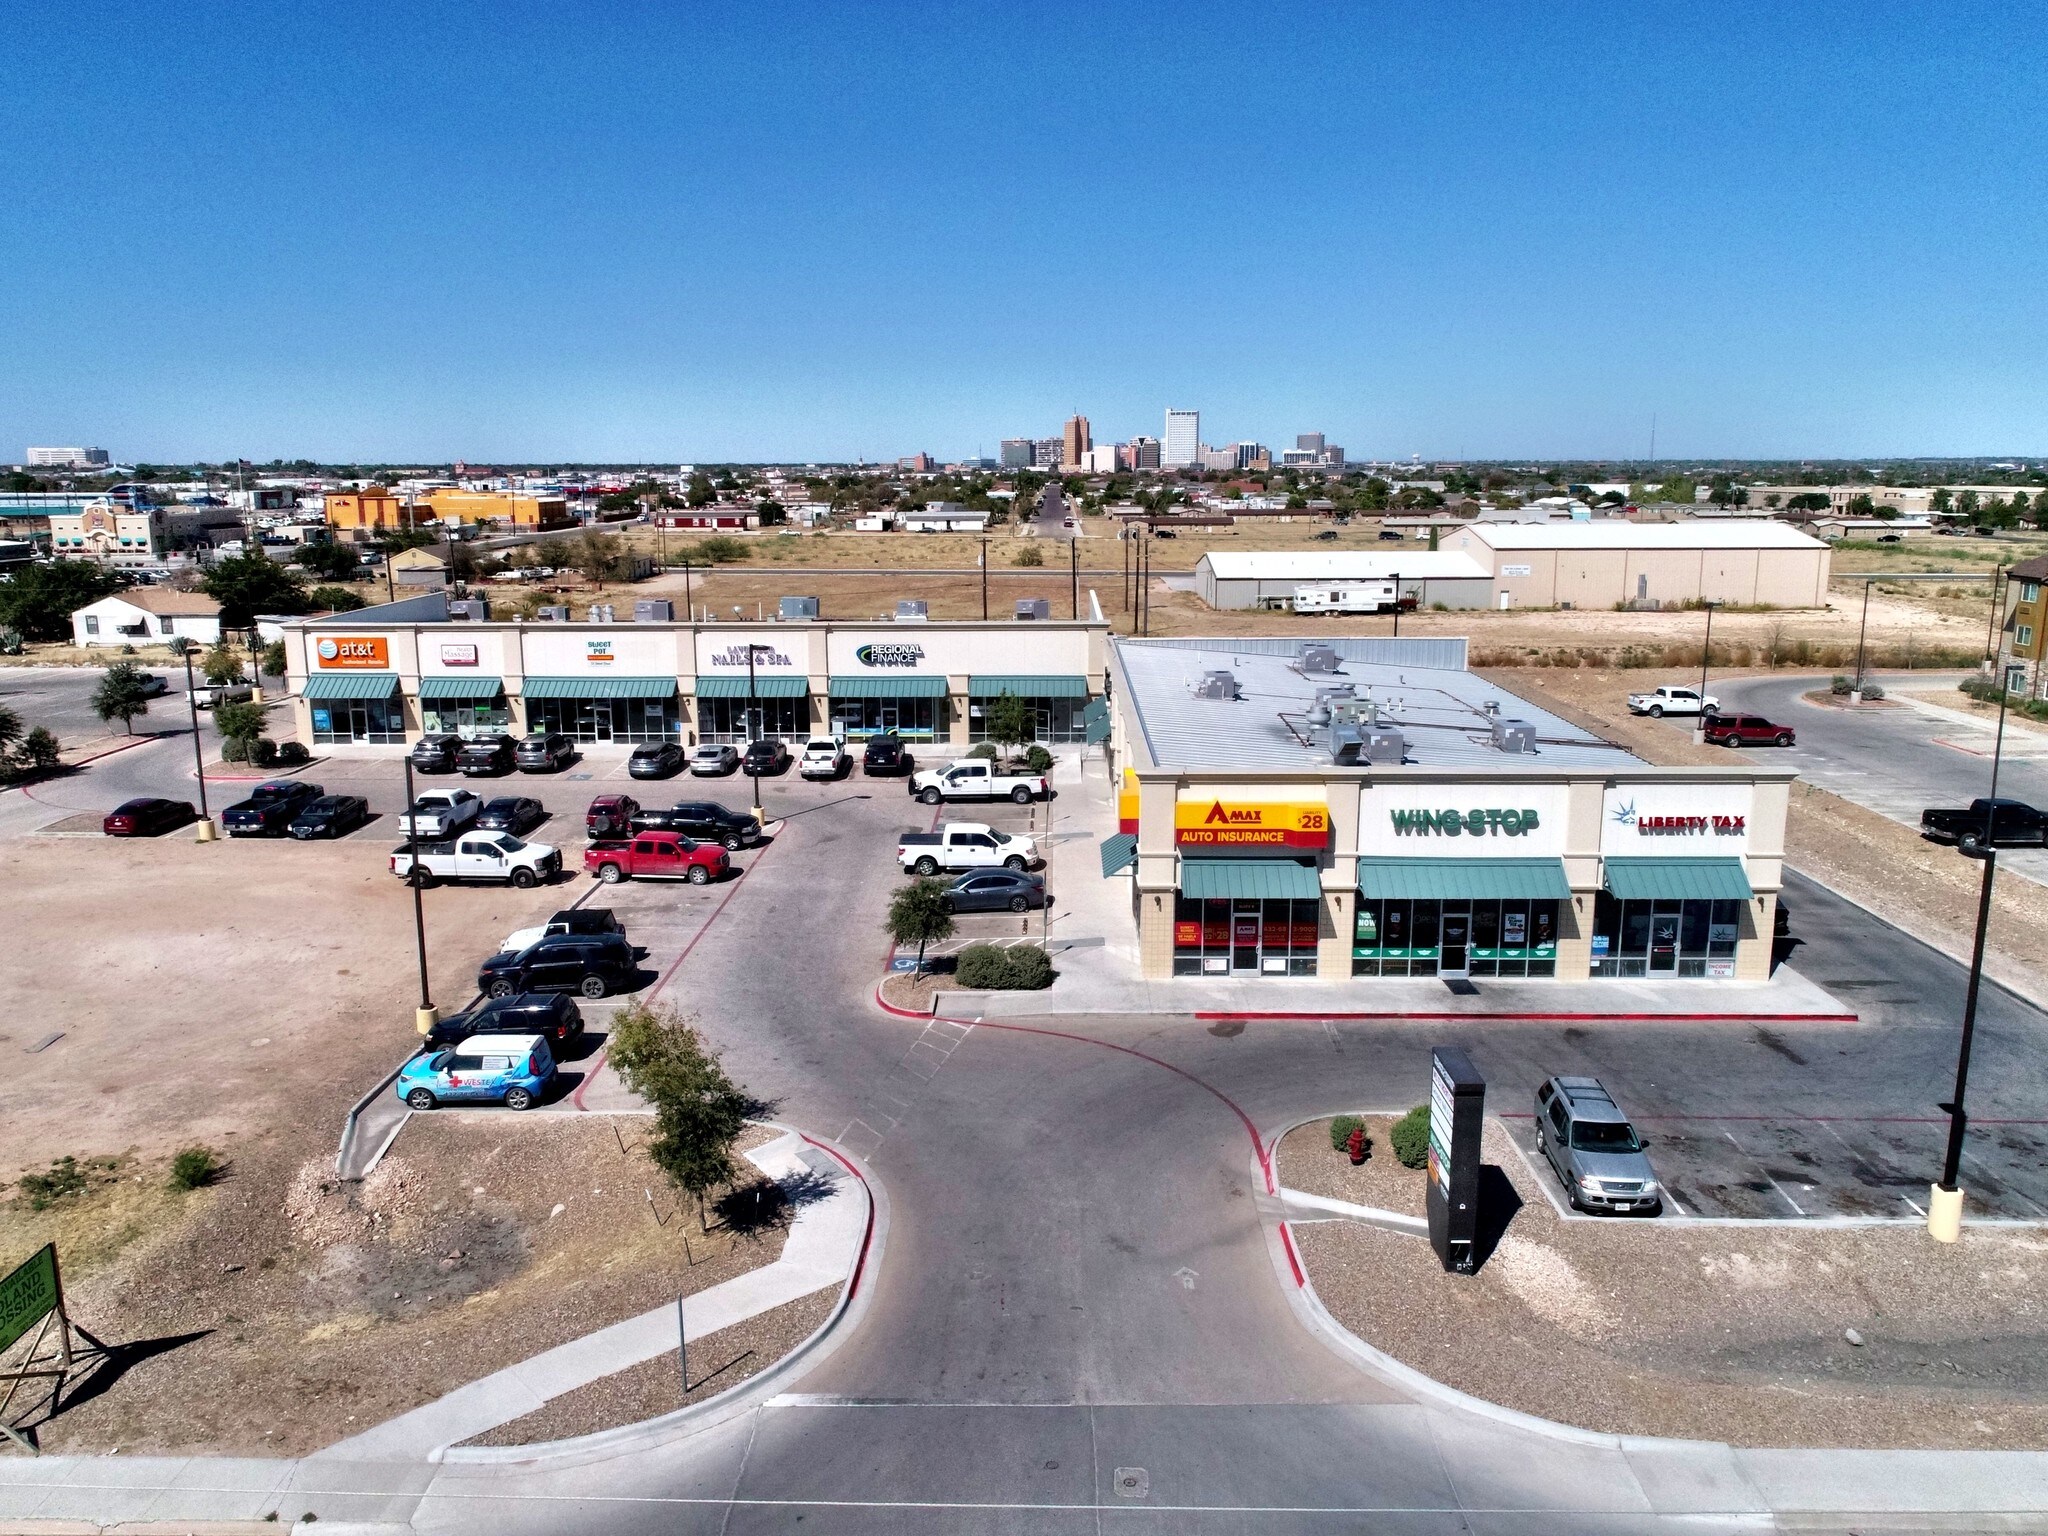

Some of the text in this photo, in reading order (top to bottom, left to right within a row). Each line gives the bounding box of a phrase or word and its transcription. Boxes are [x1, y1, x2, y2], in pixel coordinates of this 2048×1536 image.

[340, 641, 374, 656] at&t
[871, 645, 923, 654] REGIONAL
[767, 654, 792, 665] SPA
[871, 653, 915, 662] FINANCE
[1638, 815, 1745, 828] LIBERTY TAX
[1181, 831, 1285, 843] AUTO INSURANCE
[1358, 919, 1376, 927] NOW
